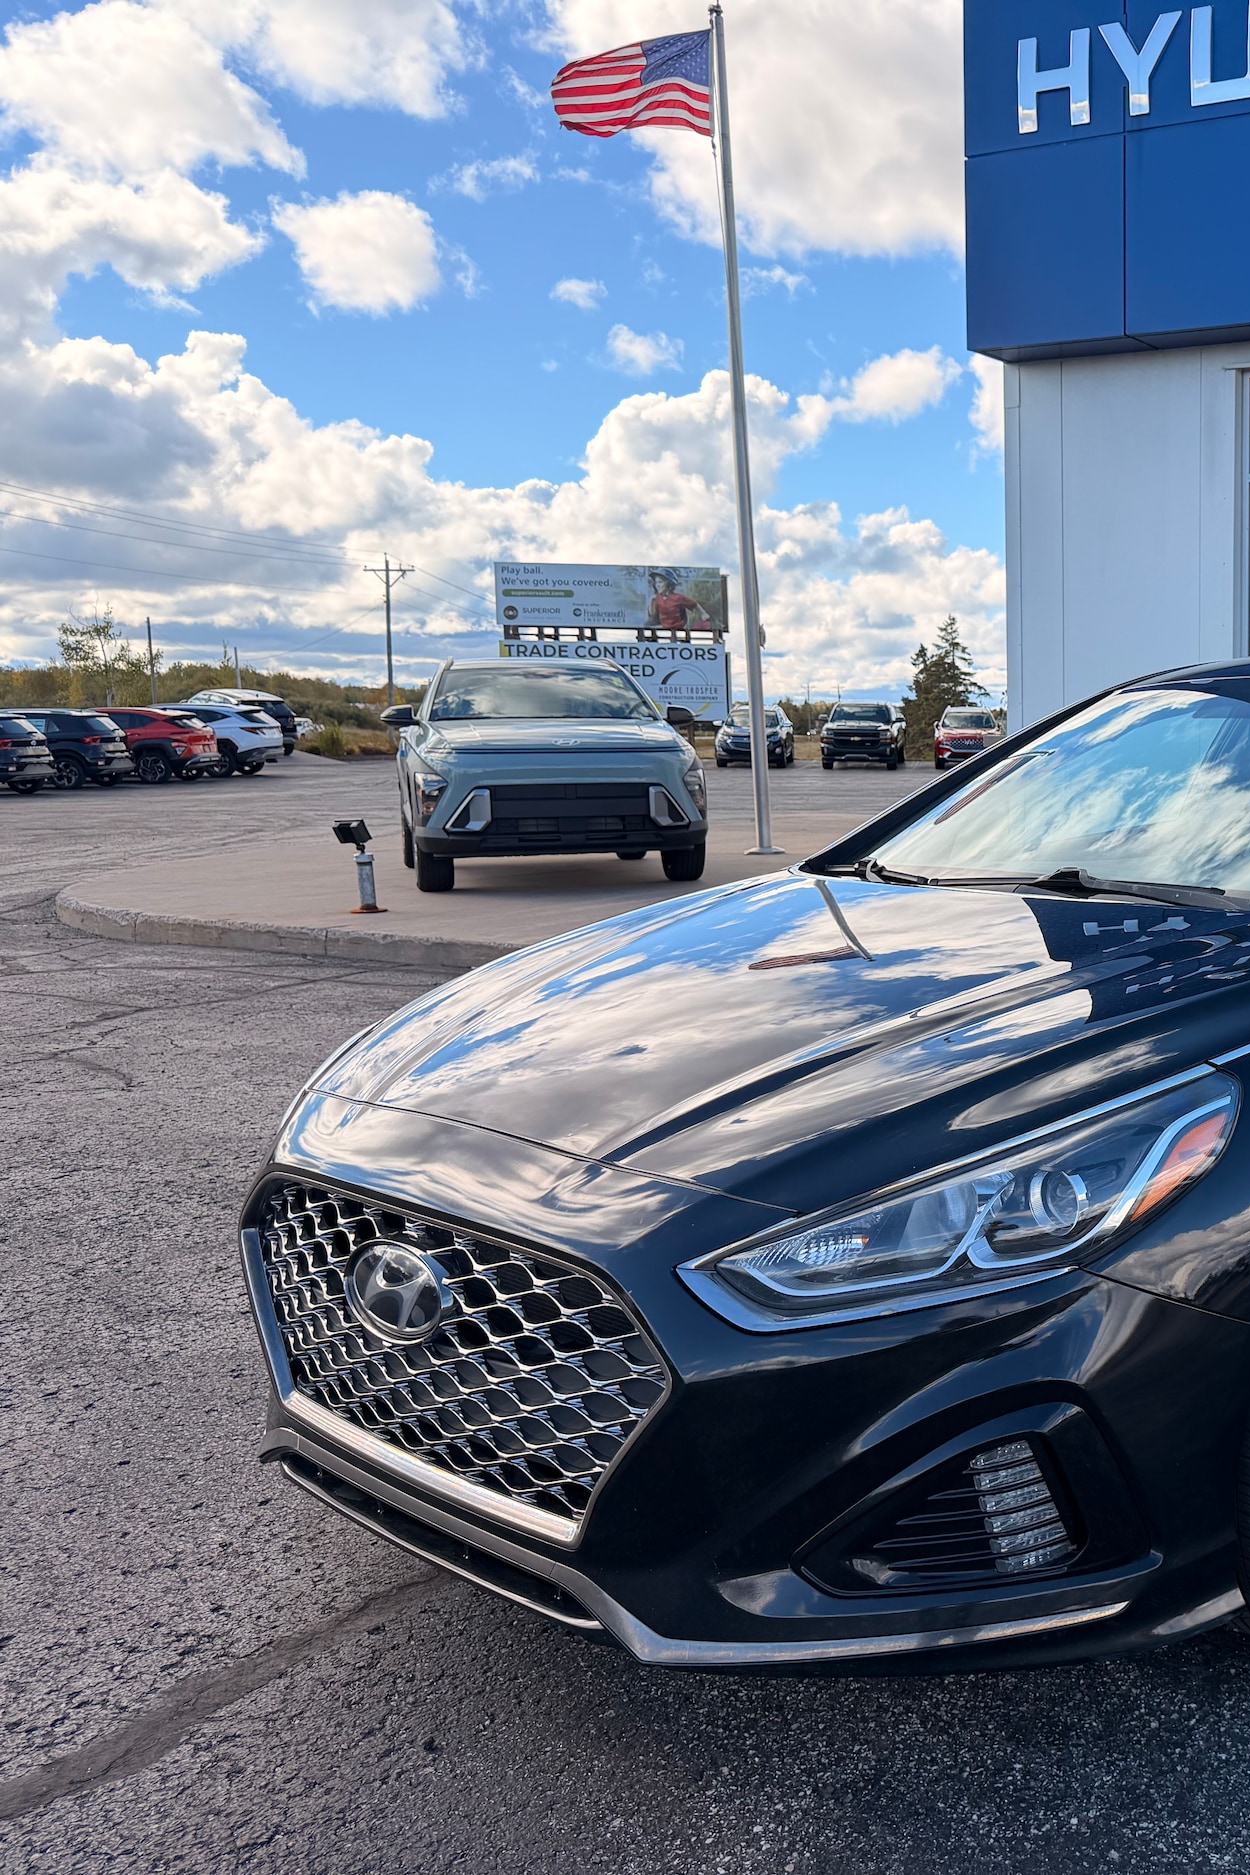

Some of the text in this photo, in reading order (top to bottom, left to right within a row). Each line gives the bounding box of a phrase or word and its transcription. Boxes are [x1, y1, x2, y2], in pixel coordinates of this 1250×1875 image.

[501, 566, 544, 575] Play ball.
[501, 577, 613, 587] We've got you covered.
[504, 644, 718, 661] TRADE CONTRACTORS
[658, 686, 719, 695] MOORE TROSPER
